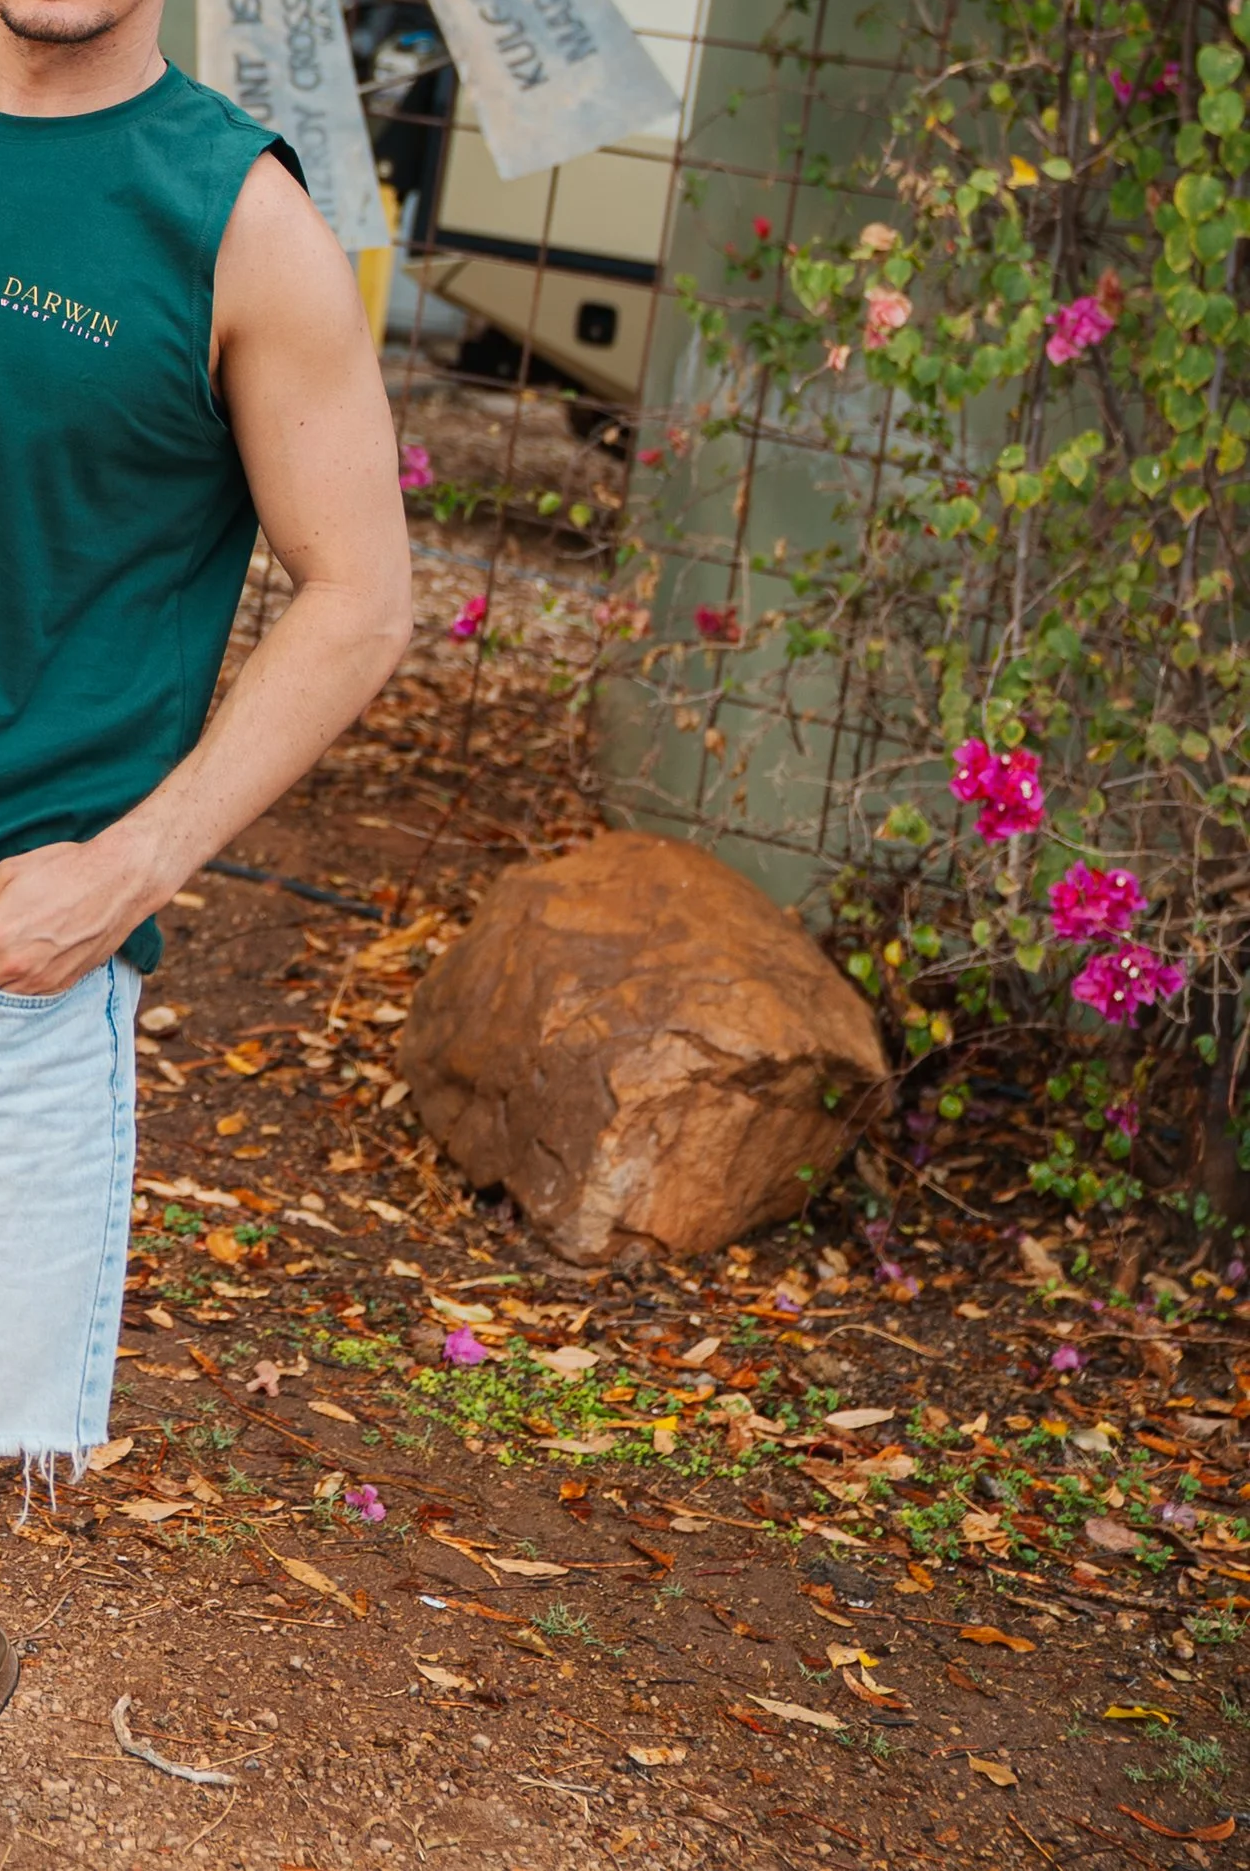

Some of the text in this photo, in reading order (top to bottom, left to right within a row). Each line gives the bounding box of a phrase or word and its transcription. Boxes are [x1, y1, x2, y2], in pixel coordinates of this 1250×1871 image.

[235, 54, 273, 126] UNT
[292, 104, 342, 234] ITZROY
[0, 297, 110, 347] water lilies
[3, 276, 119, 337] DARWIN
